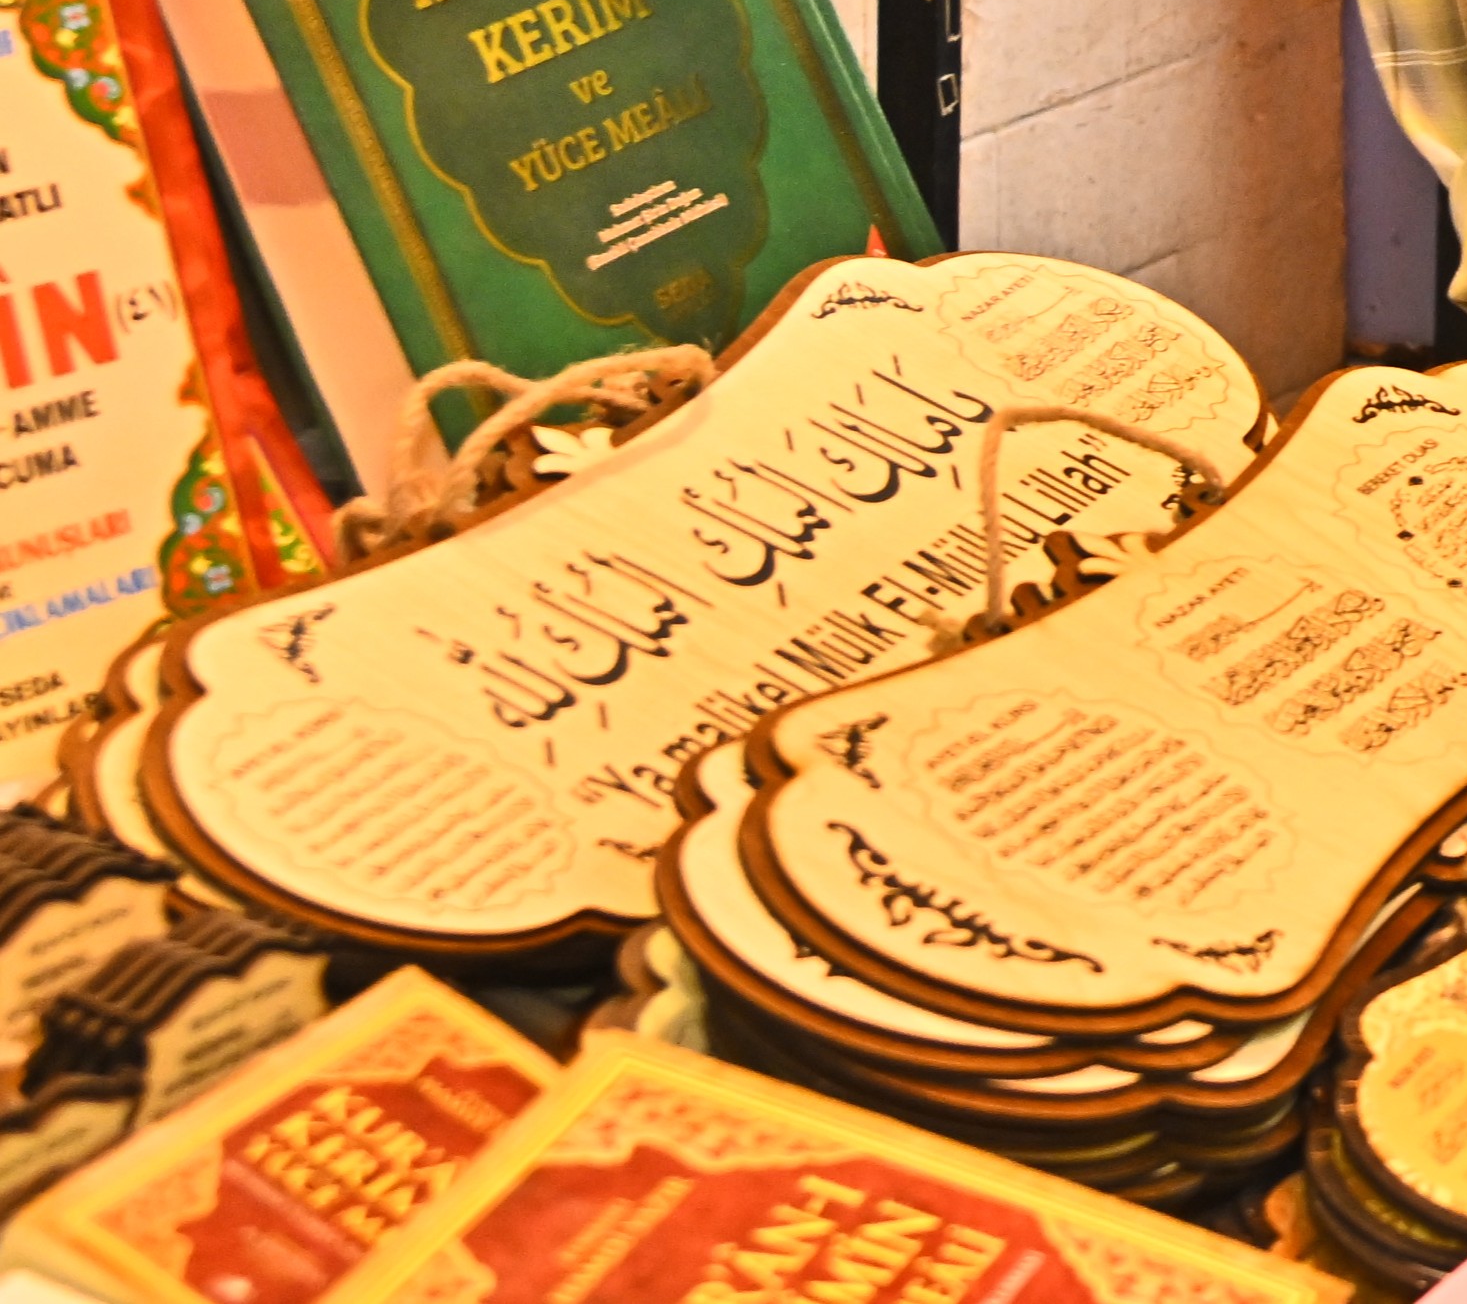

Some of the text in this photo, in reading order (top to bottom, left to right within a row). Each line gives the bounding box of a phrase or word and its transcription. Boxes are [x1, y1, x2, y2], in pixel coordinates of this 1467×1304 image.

[569, 69, 613, 105] ve
[508, 138, 606, 191] YÜCE
[774, 608, 908, 681] Mülk
